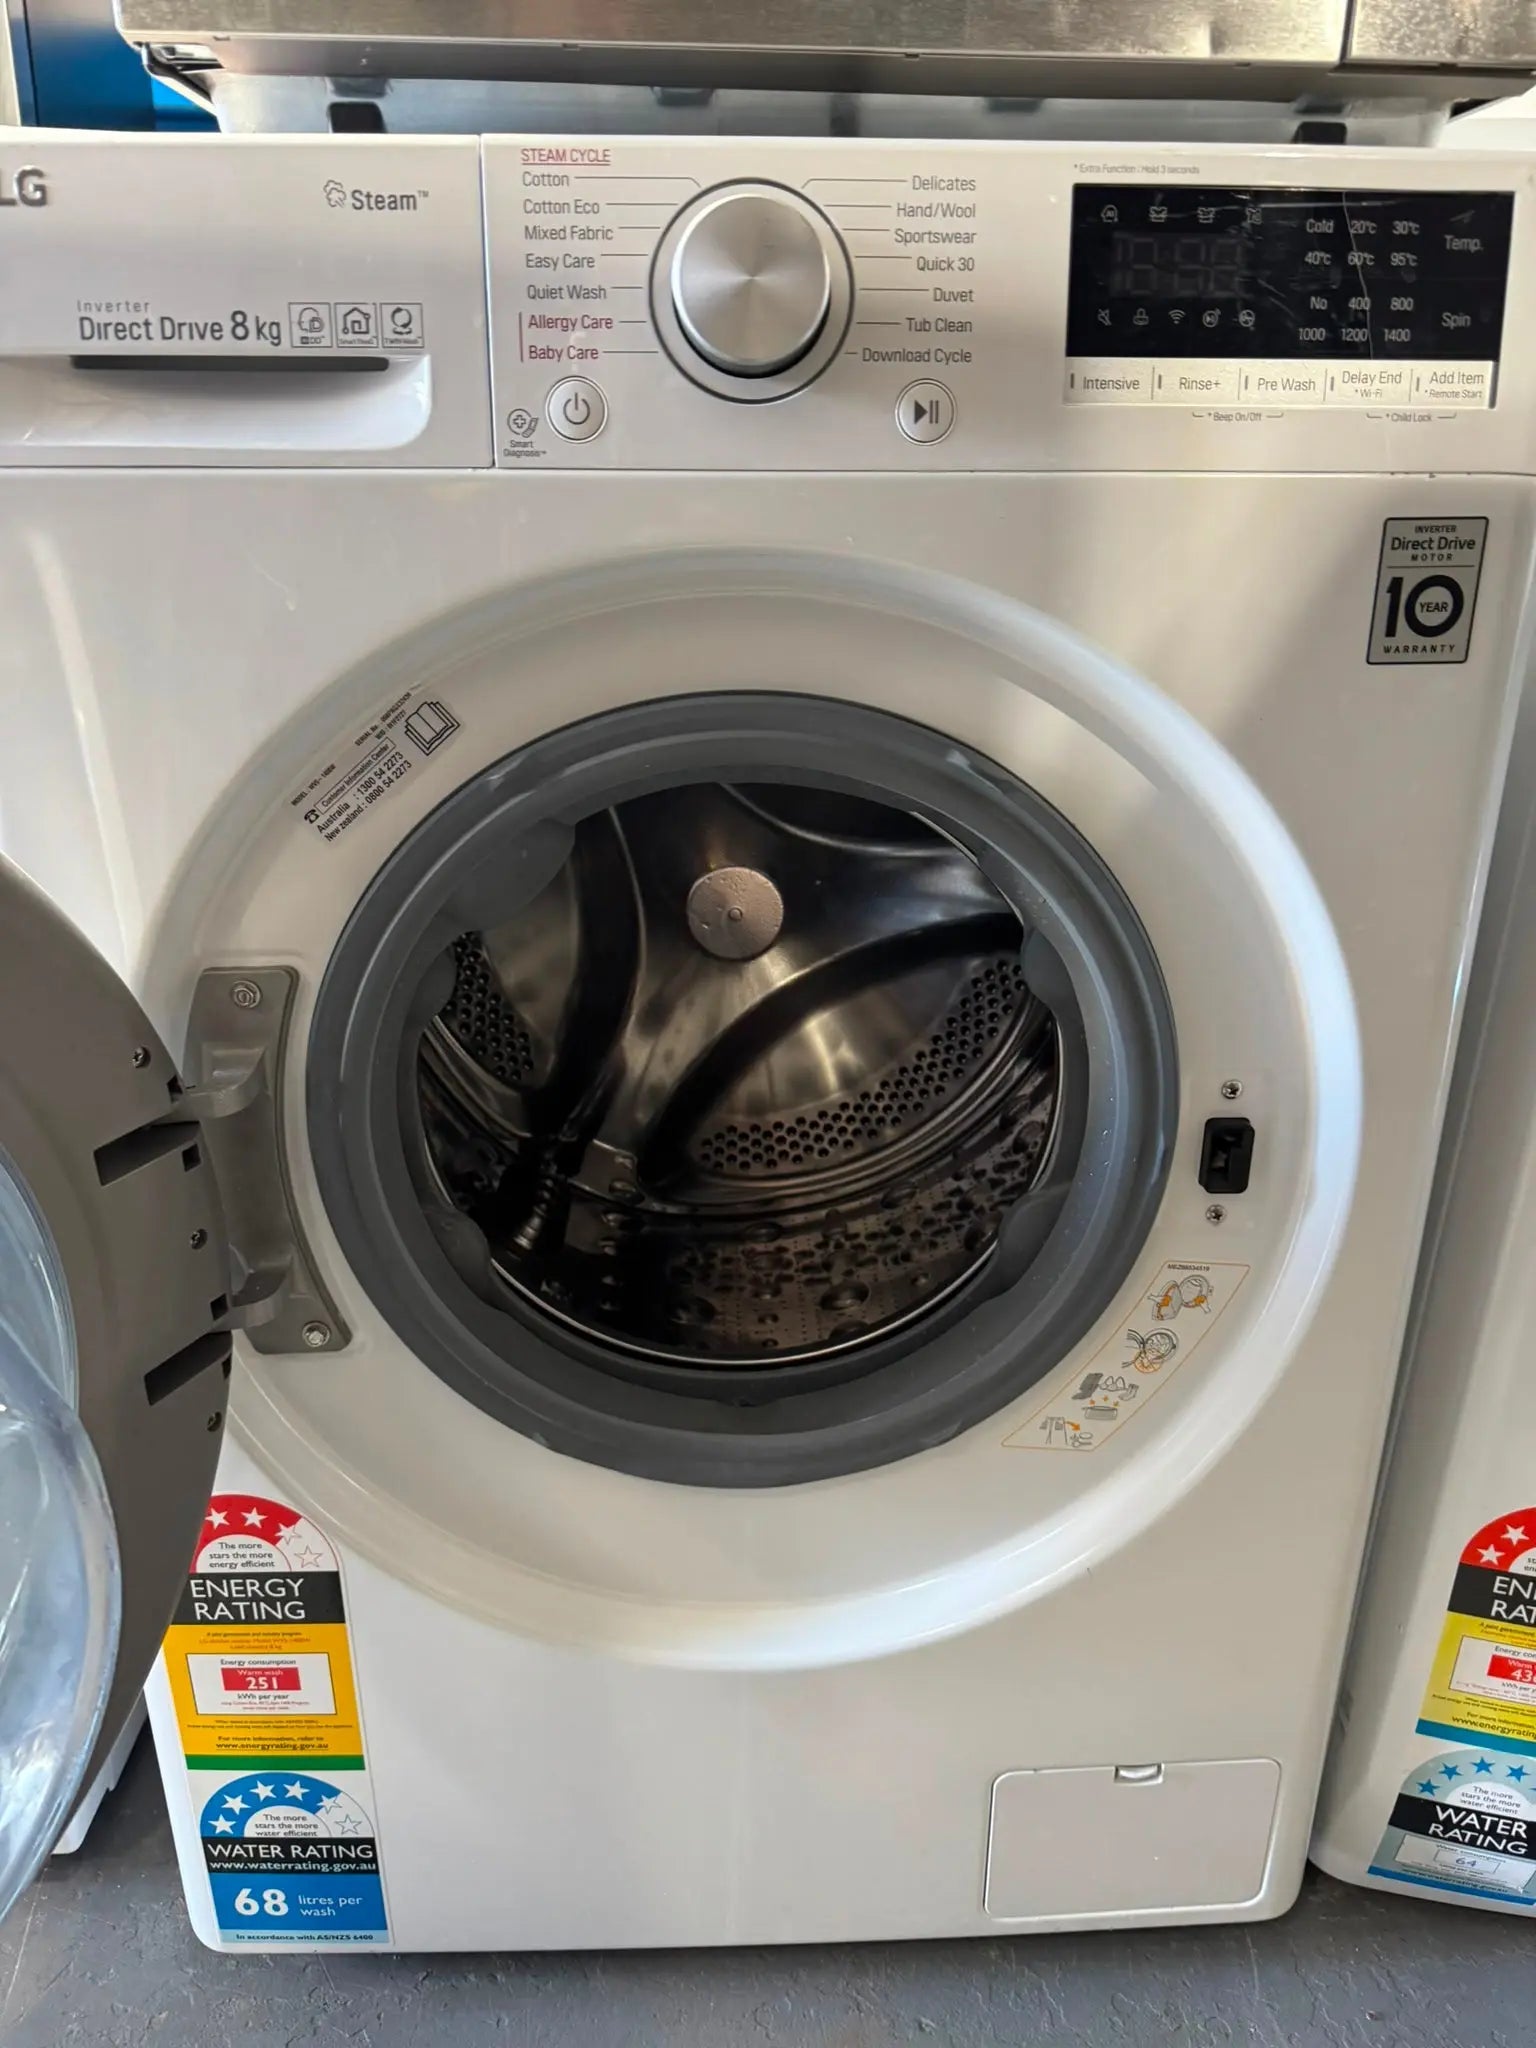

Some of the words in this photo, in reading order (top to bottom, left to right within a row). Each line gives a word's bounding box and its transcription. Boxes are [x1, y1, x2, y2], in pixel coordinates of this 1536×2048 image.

[521, 148, 566, 163] STEAM
[569, 149, 611, 163] CYCLE
[522, 172, 569, 187] Cotton
[912, 175, 977, 192] Delicates
[523, 199, 571, 215] Cotton
[574, 200, 600, 215] Eco
[896, 203, 977, 219] Hand/Wool
[1306, 219, 1334, 233] Cold
[524, 226, 567, 241] Mixed
[572, 226, 613, 241] Fabric
[894, 229, 977, 247] Sportswear
[1444, 235, 1484, 252] Temp.
[526, 254, 559, 272] Easy
[563, 254, 595, 269] Care
[916, 256, 955, 273] Quick
[958, 257, 975, 272] 30
[527, 285, 563, 301] Quiet
[566, 285, 607, 300] Wash
[933, 288, 974, 303] Duvet
[77, 300, 151, 314] Inverter
[1309, 297, 1328, 310] No
[1348, 297, 1371, 310] 400
[1390, 298, 1414, 310] 800
[528, 315, 576, 332] Allergy
[578, 315, 613, 330] Care
[906, 318, 932, 333] Tub
[935, 318, 973, 333] Clean
[1441, 312, 1472, 329] Spin
[79, 316, 153, 342] Direct
[161, 316, 224, 342] Drive
[229, 310, 250, 342] 8
[255, 316, 282, 346] kg
[1299, 328, 1326, 341] 1000
[1341, 329, 1368, 341] 1200
[1384, 329, 1411, 342] 1400
[529, 345, 563, 363] Baby
[567, 345, 600, 360] Care
[862, 349, 929, 363] Download
[932, 349, 973, 365] Cycle
[1082, 376, 1141, 390] Intensive
[1179, 377, 1221, 390] Rinse+
[1257, 377, 1278, 390] Pre
[1281, 378, 1316, 391] Wash
[1342, 371, 1375, 385] Delay
[1379, 371, 1402, 384] End
[1430, 371, 1454, 385] Add
[1457, 371, 1485, 385] Item
[1429, 389, 1459, 398] Remote
[1461, 390, 1483, 398] Start
[1213, 412, 1233, 421] Beep
[1235, 412, 1262, 421] On/Off
[1391, 413, 1412, 421] Child
[1413, 413, 1432, 422] Lock
[510, 440, 535, 448] Smart
[1414, 525, 1457, 533] INVERTER
[1391, 536, 1435, 550] Direct
[1437, 536, 1476, 550] Drive
[1411, 553, 1453, 561] MOTOR
[1385, 574, 1464, 638] 10
[1419, 602, 1448, 613] YEAR
[1383, 644, 1456, 654] WARRANTY
[321, 784, 346, 808] Customer
[345, 760, 373, 786] Information
[371, 743, 390, 761] Center
[317, 802, 351, 834] Australia
[357, 777, 376, 796] 1300
[374, 768, 386, 781] 54
[383, 751, 404, 773] 2273
[324, 826, 341, 842] New
[339, 806, 364, 830] zealand
[365, 786, 385, 804] 0800
[383, 778, 395, 790] 54
[391, 760, 412, 779] 2273
[219, 1542, 236, 1550] The
[209, 1551, 231, 1560] stars
[233, 1551, 248, 1560] the
[249, 1551, 273, 1560] more
[209, 1560, 238, 1570] energy
[240, 1560, 275, 1568] efficient
[190, 1578, 304, 1599] ENERGY
[1493, 1576, 1536, 1600] EN
[194, 1601, 306, 1621] RATING
[1494, 1645, 1521, 1656] Energy
[220, 1659, 246, 1667] Energy
[248, 1658, 296, 1667] consumption
[1508, 1659, 1533, 1669] Warm
[1511, 1669, 1536, 1682] 43
[246, 1676, 280, 1690] 251
[273, 1693, 290, 1701] year
[216, 1742, 329, 1751] www.energyrating.gov.au
[1461, 1792, 1480, 1801] stars
[1483, 1795, 1498, 1803] the
[1499, 1800, 1521, 1808] more
[1473, 1786, 1489, 1795] The
[1491, 1791, 1513, 1800] more
[1461, 1799, 1485, 1808] water
[1486, 1804, 1519, 1815] efficient
[255, 1822, 273, 1830] stars
[1435, 1805, 1528, 1839] WATER
[1428, 1822, 1529, 1855] RATING
[207, 1844, 285, 1859] WATER
[291, 1845, 373, 1858] RATING
[208, 1861, 376, 1873] www.waterrating.gov.au
[1455, 1857, 1477, 1867] 64
[234, 1888, 289, 1916] 68
[298, 1894, 334, 1905] litres
[339, 1896, 363, 1907] per
[300, 1907, 336, 1917] wash
[317, 1933, 351, 1941] AS/NZS
